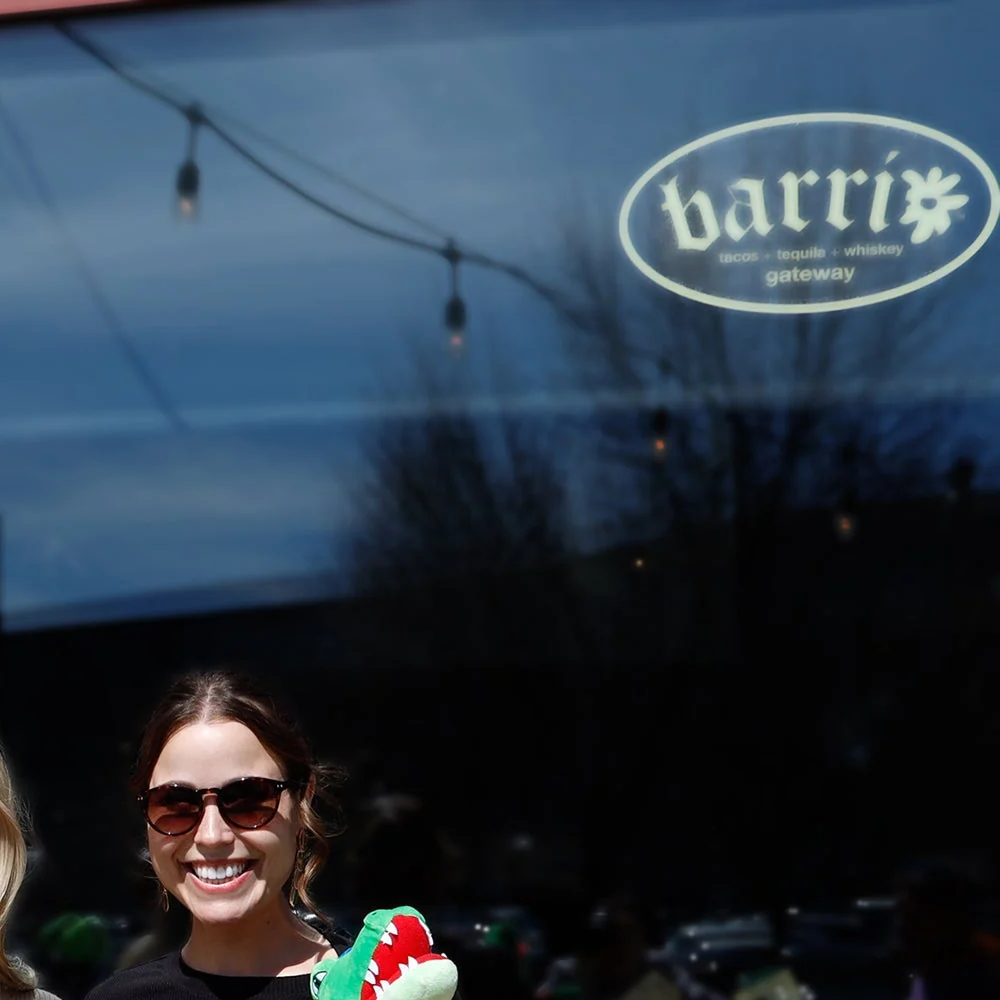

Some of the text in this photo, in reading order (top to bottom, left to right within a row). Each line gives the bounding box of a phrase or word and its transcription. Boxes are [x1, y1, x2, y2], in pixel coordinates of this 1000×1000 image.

[719, 251, 759, 264] tacos
[777, 246, 826, 262] tequila
[844, 243, 905, 257] whiskey
[765, 265, 856, 288] gateway
